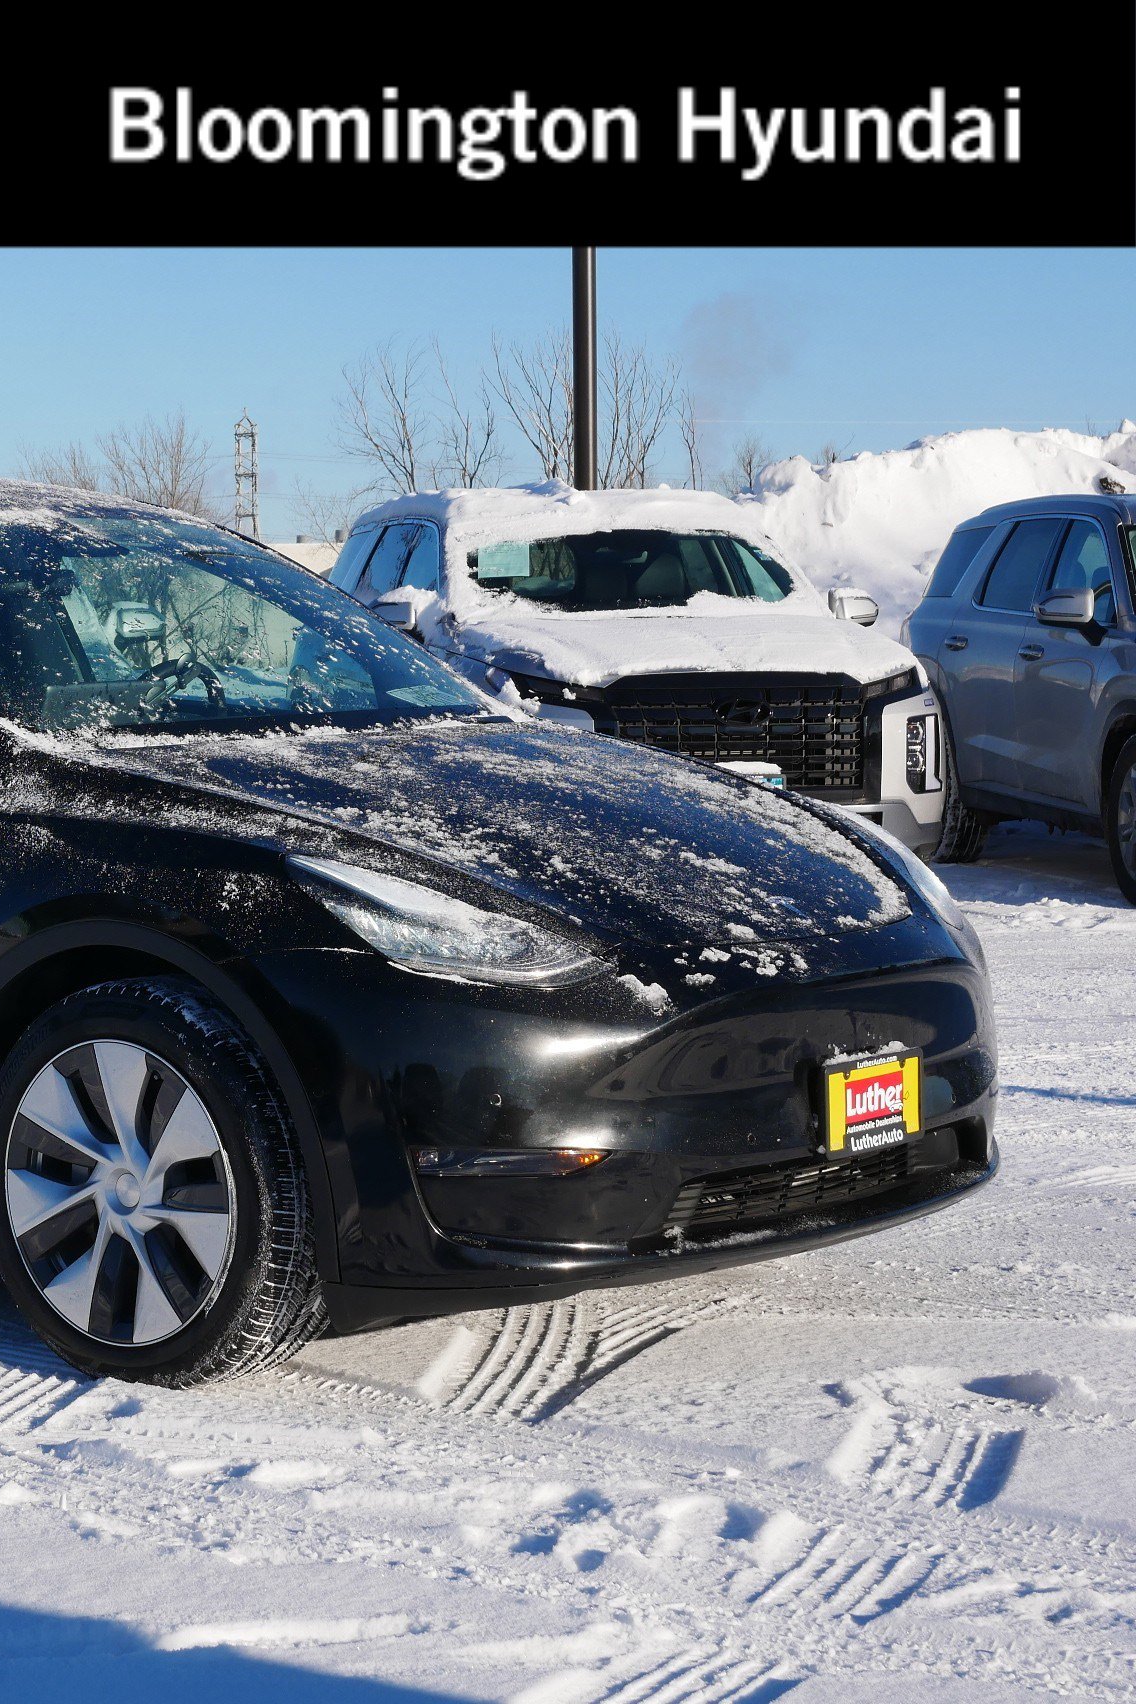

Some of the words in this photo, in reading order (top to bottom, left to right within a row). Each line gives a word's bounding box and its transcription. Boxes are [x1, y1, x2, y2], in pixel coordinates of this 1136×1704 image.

[857, 1056, 898, 1069] LutherAuto.com
[847, 1082, 903, 1117] Luther
[846, 1121, 876, 1134] Automobile
[875, 1115, 903, 1128] Dealerships
[850, 1128, 903, 1151] LutherAuto
